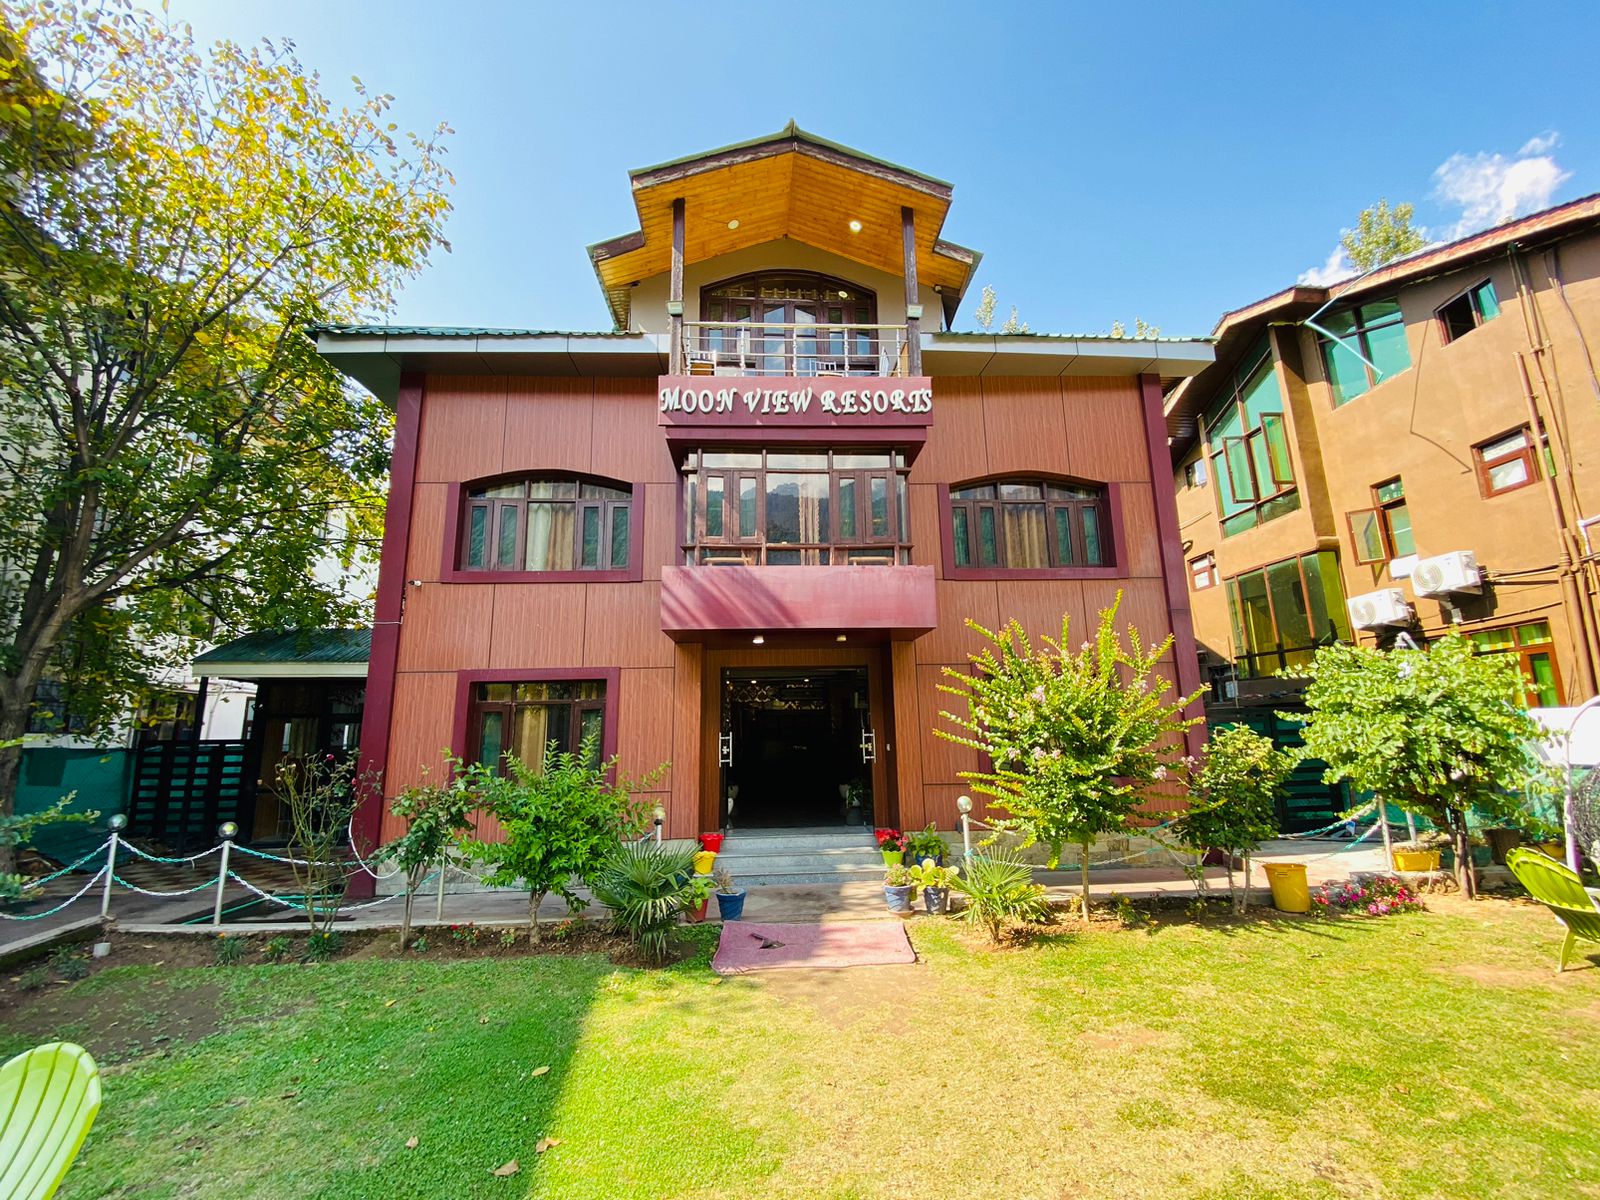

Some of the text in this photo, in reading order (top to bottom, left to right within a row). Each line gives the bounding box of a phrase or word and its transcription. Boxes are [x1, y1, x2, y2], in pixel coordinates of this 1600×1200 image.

[660, 386, 933, 415] MOON VIEW RESORTS
